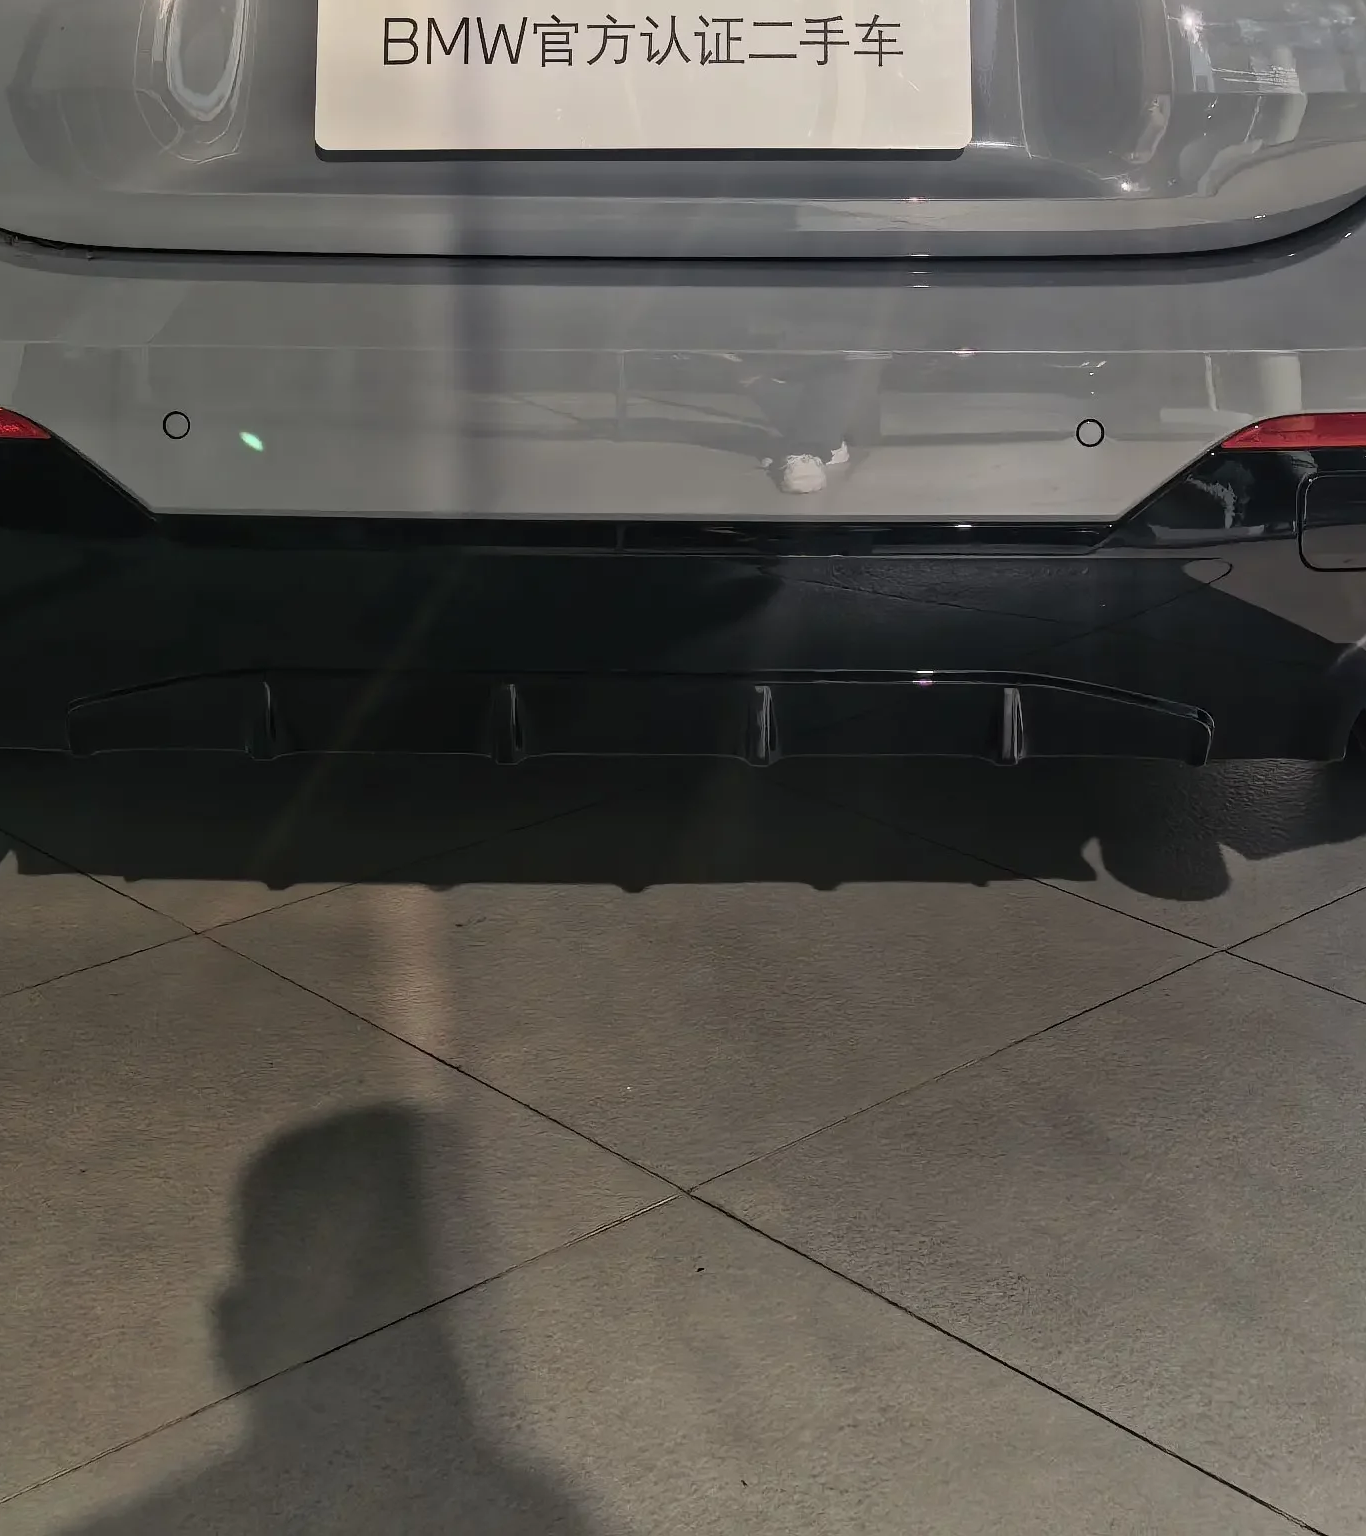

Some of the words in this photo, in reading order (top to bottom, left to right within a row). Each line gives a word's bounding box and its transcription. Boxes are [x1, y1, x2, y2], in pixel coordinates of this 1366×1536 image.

[382, 13, 905, 68] BMW官方认证二手车
